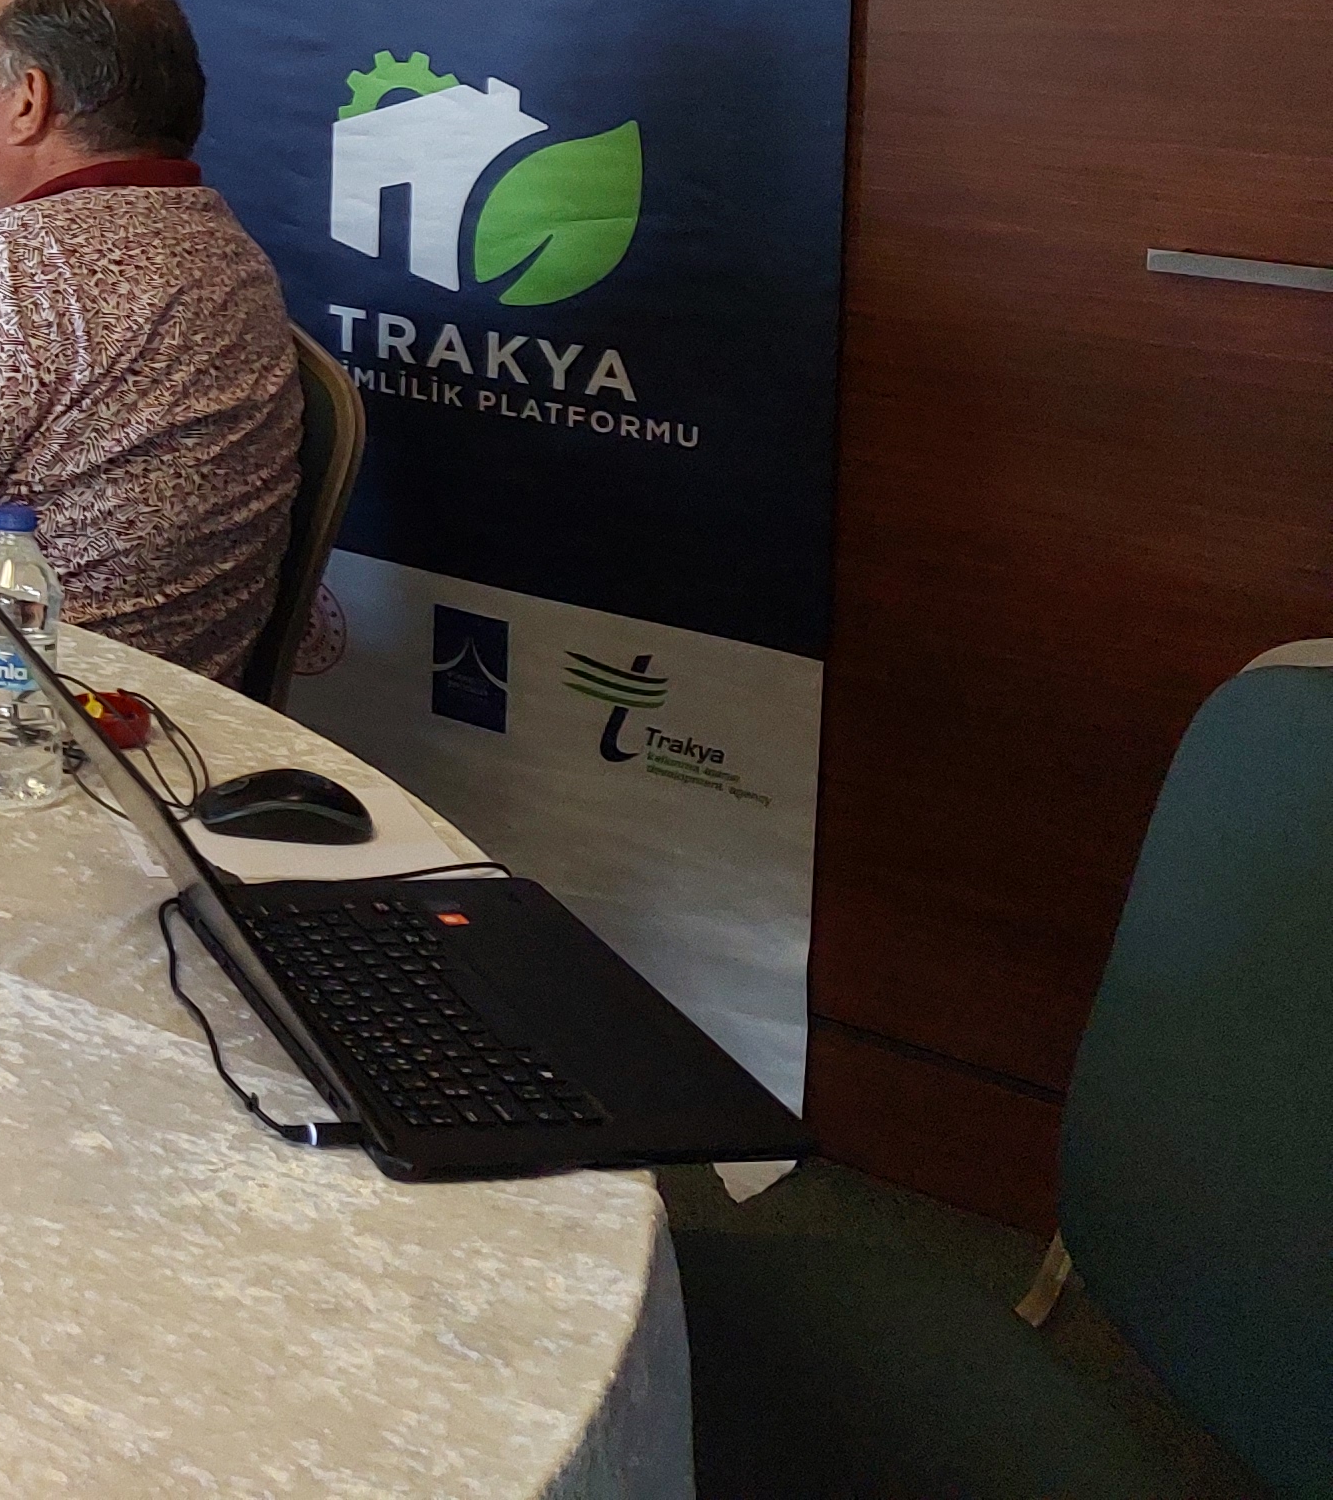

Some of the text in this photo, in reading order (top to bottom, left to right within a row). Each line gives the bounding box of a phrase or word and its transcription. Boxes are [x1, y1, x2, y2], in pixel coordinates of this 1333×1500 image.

[330, 304, 637, 402] TRAKYA
[479, 389, 700, 448] PLATFORMU
[646, 726, 725, 764] Trakya
